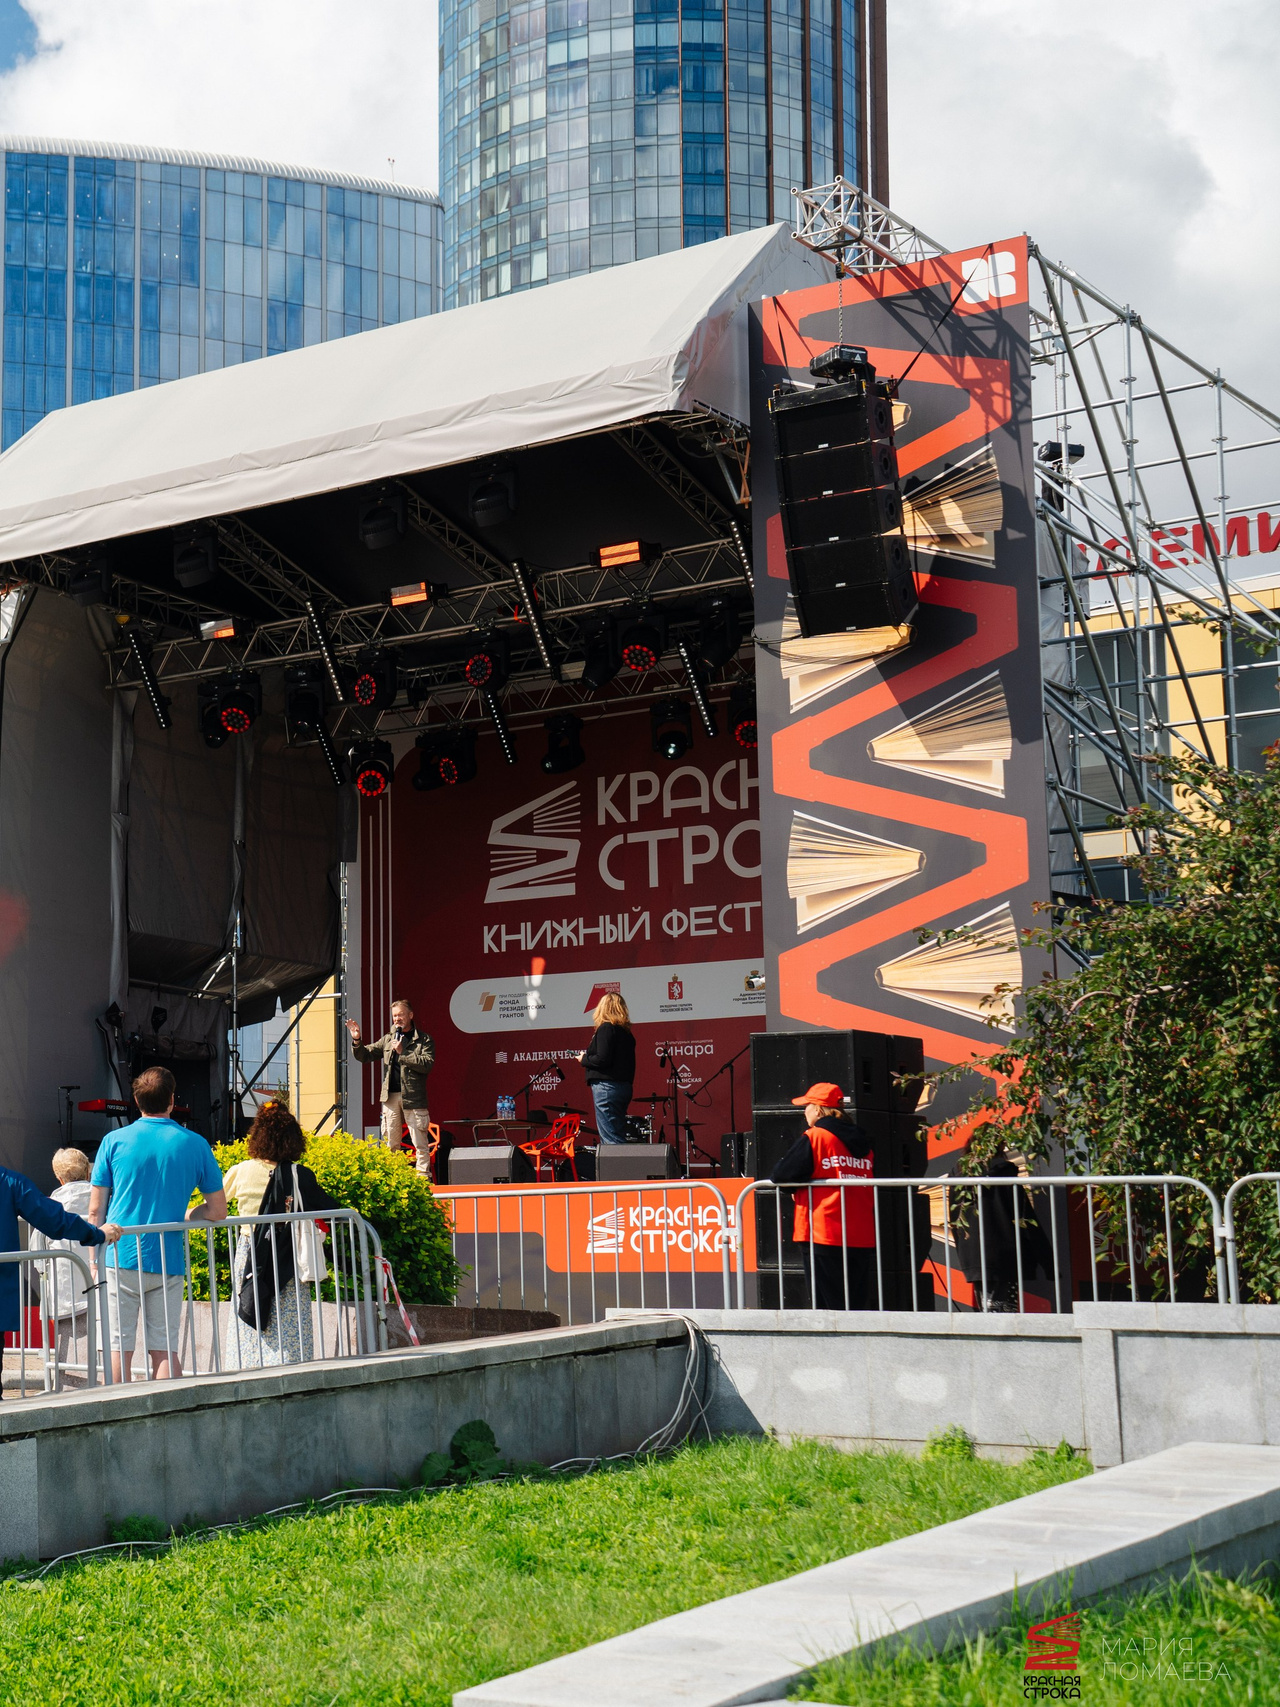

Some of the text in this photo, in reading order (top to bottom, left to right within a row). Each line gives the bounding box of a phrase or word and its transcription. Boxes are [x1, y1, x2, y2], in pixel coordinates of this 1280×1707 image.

[483, 901, 762, 954] КНИЖНЫЙ ФЕСТ
[532, 1083, 558, 1093] март
[821, 1155, 873, 1171] SECURIT
[629, 1205, 735, 1227] КРАСНАЯ
[630, 1229, 736, 1254] СТРОКА
